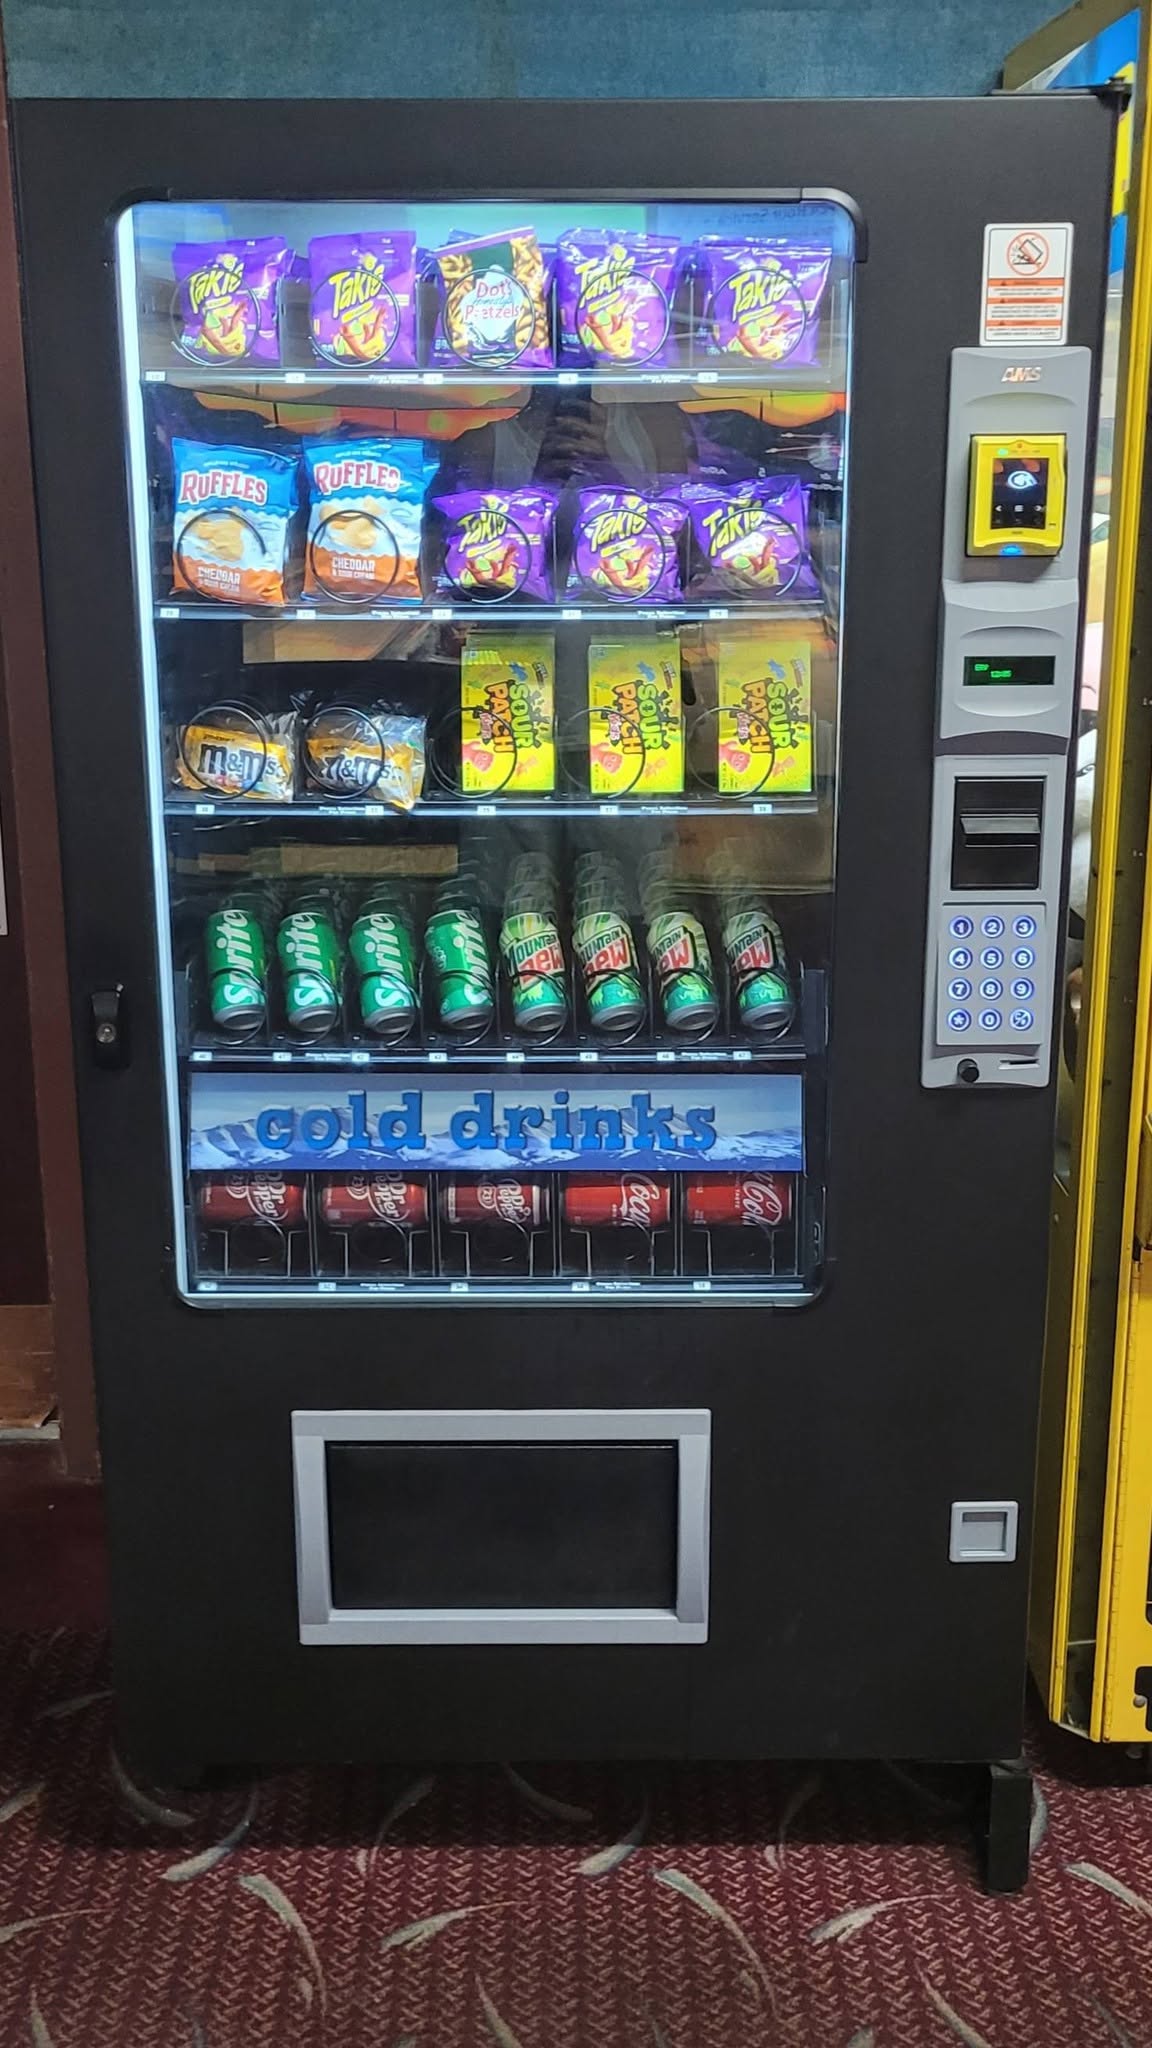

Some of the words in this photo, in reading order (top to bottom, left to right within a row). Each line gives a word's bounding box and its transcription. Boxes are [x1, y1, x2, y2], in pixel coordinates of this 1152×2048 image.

[189, 263, 244, 314] Takis
[328, 264, 385, 319] Takis
[574, 256, 636, 309] Takis
[729, 270, 792, 322] Takis
[1001, 366, 1042, 383] AMS
[180, 470, 268, 506] RUFFLES
[313, 460, 402, 496] RUFFLES
[588, 504, 649, 552] Takis
[197, 566, 241, 585] CHEDDAR
[332, 556, 376, 572] CHEDDAR
[485, 680, 515, 753] PATCH
[509, 682, 535, 748] SOUR
[613, 680, 643, 754] PATCH
[637, 682, 664, 749] SOUR
[742, 680, 773, 754] PATCH
[767, 682, 793, 749] SOUR
[956, 922, 965, 932] 1
[988, 922, 997, 932] 2
[1019, 922, 1028, 932] 3
[216, 911, 262, 1004] Sprite
[286, 914, 331, 1006] Sprite
[363, 915, 411, 1008] Sprite
[955, 953, 965, 964] 4
[987, 953, 996, 964] 5
[1018, 953, 1027, 964] 6
[955, 984, 963, 995] 7
[986, 984, 995, 995] 8
[1017, 984, 1026, 995] 9
[986, 1015, 994, 1026] 0
[256, 1088, 426, 1150] cold
[450, 1088, 717, 1151] drinks
[389, 1182, 407, 1205] Dr
